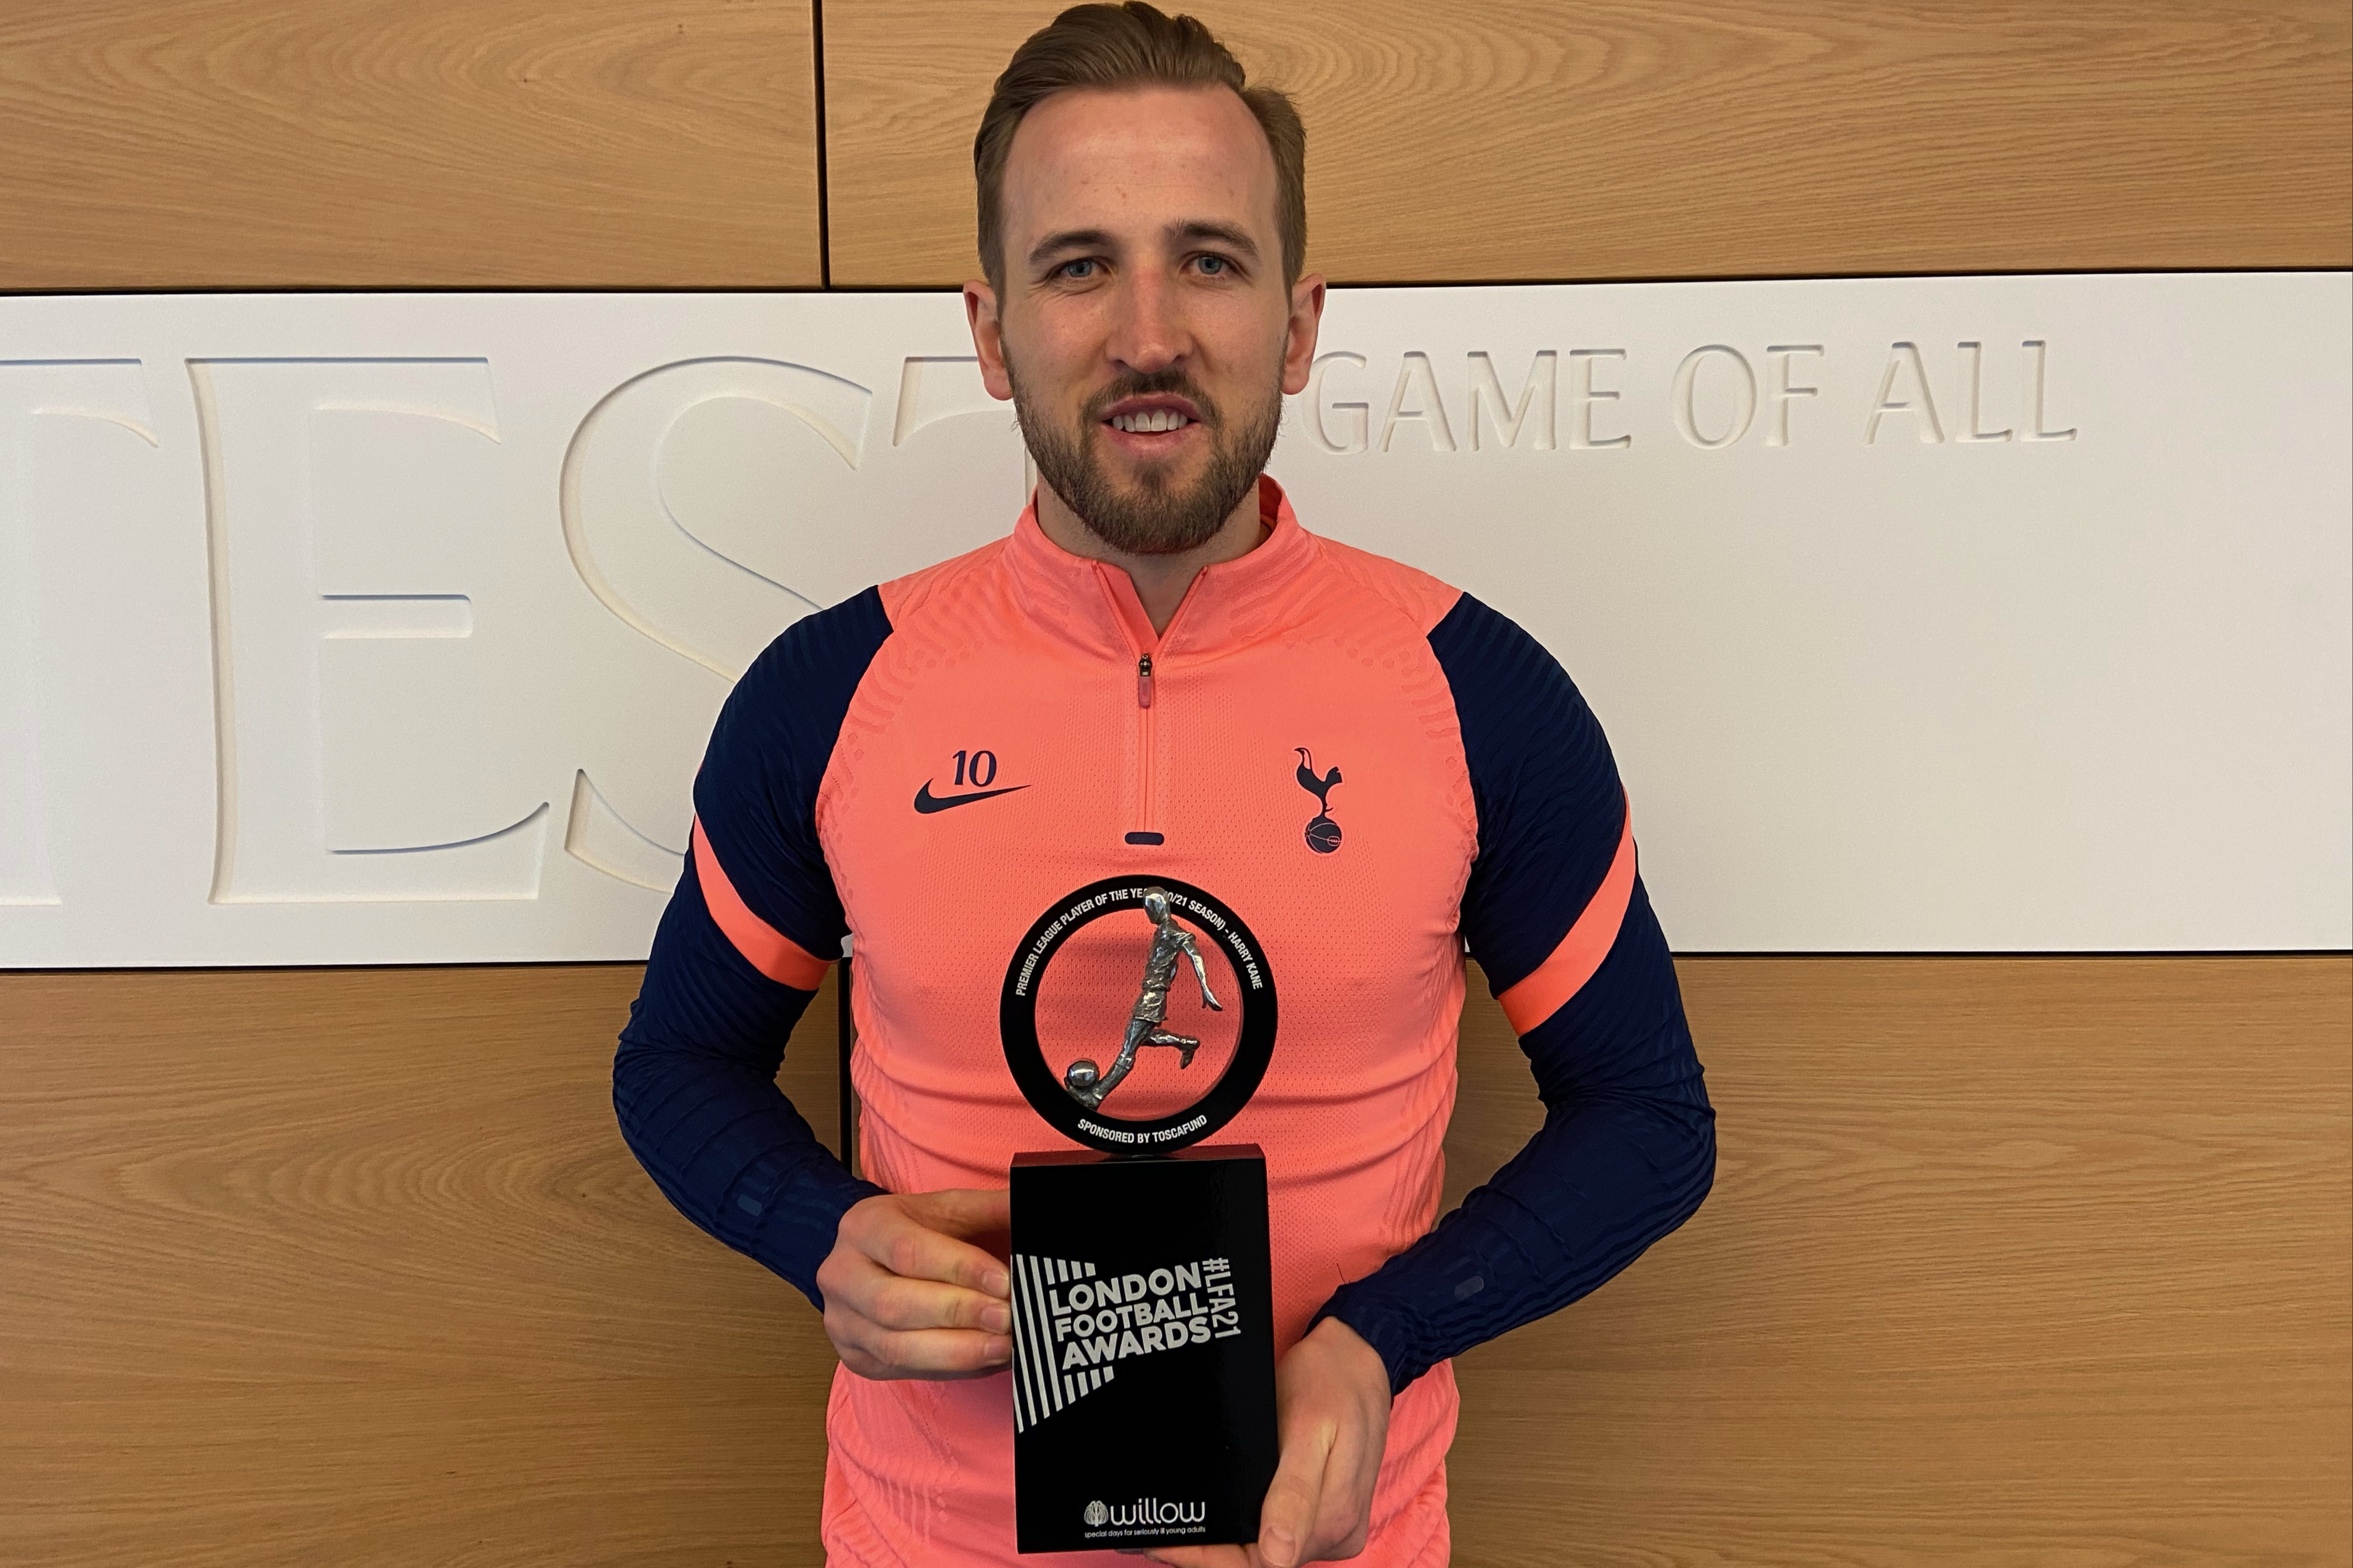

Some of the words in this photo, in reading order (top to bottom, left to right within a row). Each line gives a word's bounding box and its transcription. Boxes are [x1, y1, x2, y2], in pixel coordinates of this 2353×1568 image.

[1299, 348, 1632, 456] GAME
[1669, 343, 1825, 451] OF
[1862, 339, 2080, 445] ALL
[0, 354, 1039, 906] ES
[952, 750, 998, 787] 10
[1016, 952, 1039, 996] PREMIER
[1033, 920, 1063, 954] LEAGUE
[1060, 899, 1095, 926] PLAYER
[1095, 893, 1108, 906] OF
[1109, 889, 1129, 902] THE
[1188, 900, 1226, 931] SEASON)
[1227, 931, 1254, 962] HARRY
[1246, 962, 1263, 990] KANE
[1078, 1119, 1134, 1143] SPONSORED
[1137, 1133, 1150, 1143] BY
[1152, 1114, 1207, 1143] TOSCAFUND
[1050, 1262, 1202, 1316] LONDON
[1202, 1257, 1241, 1339] #LFA21
[1055, 1293, 1209, 1341] FOOTBALL
[1062, 1316, 1211, 1370] AWARDS
[1085, 1529, 1107, 1539] special
[1110, 1498, 1205, 1525] willow
